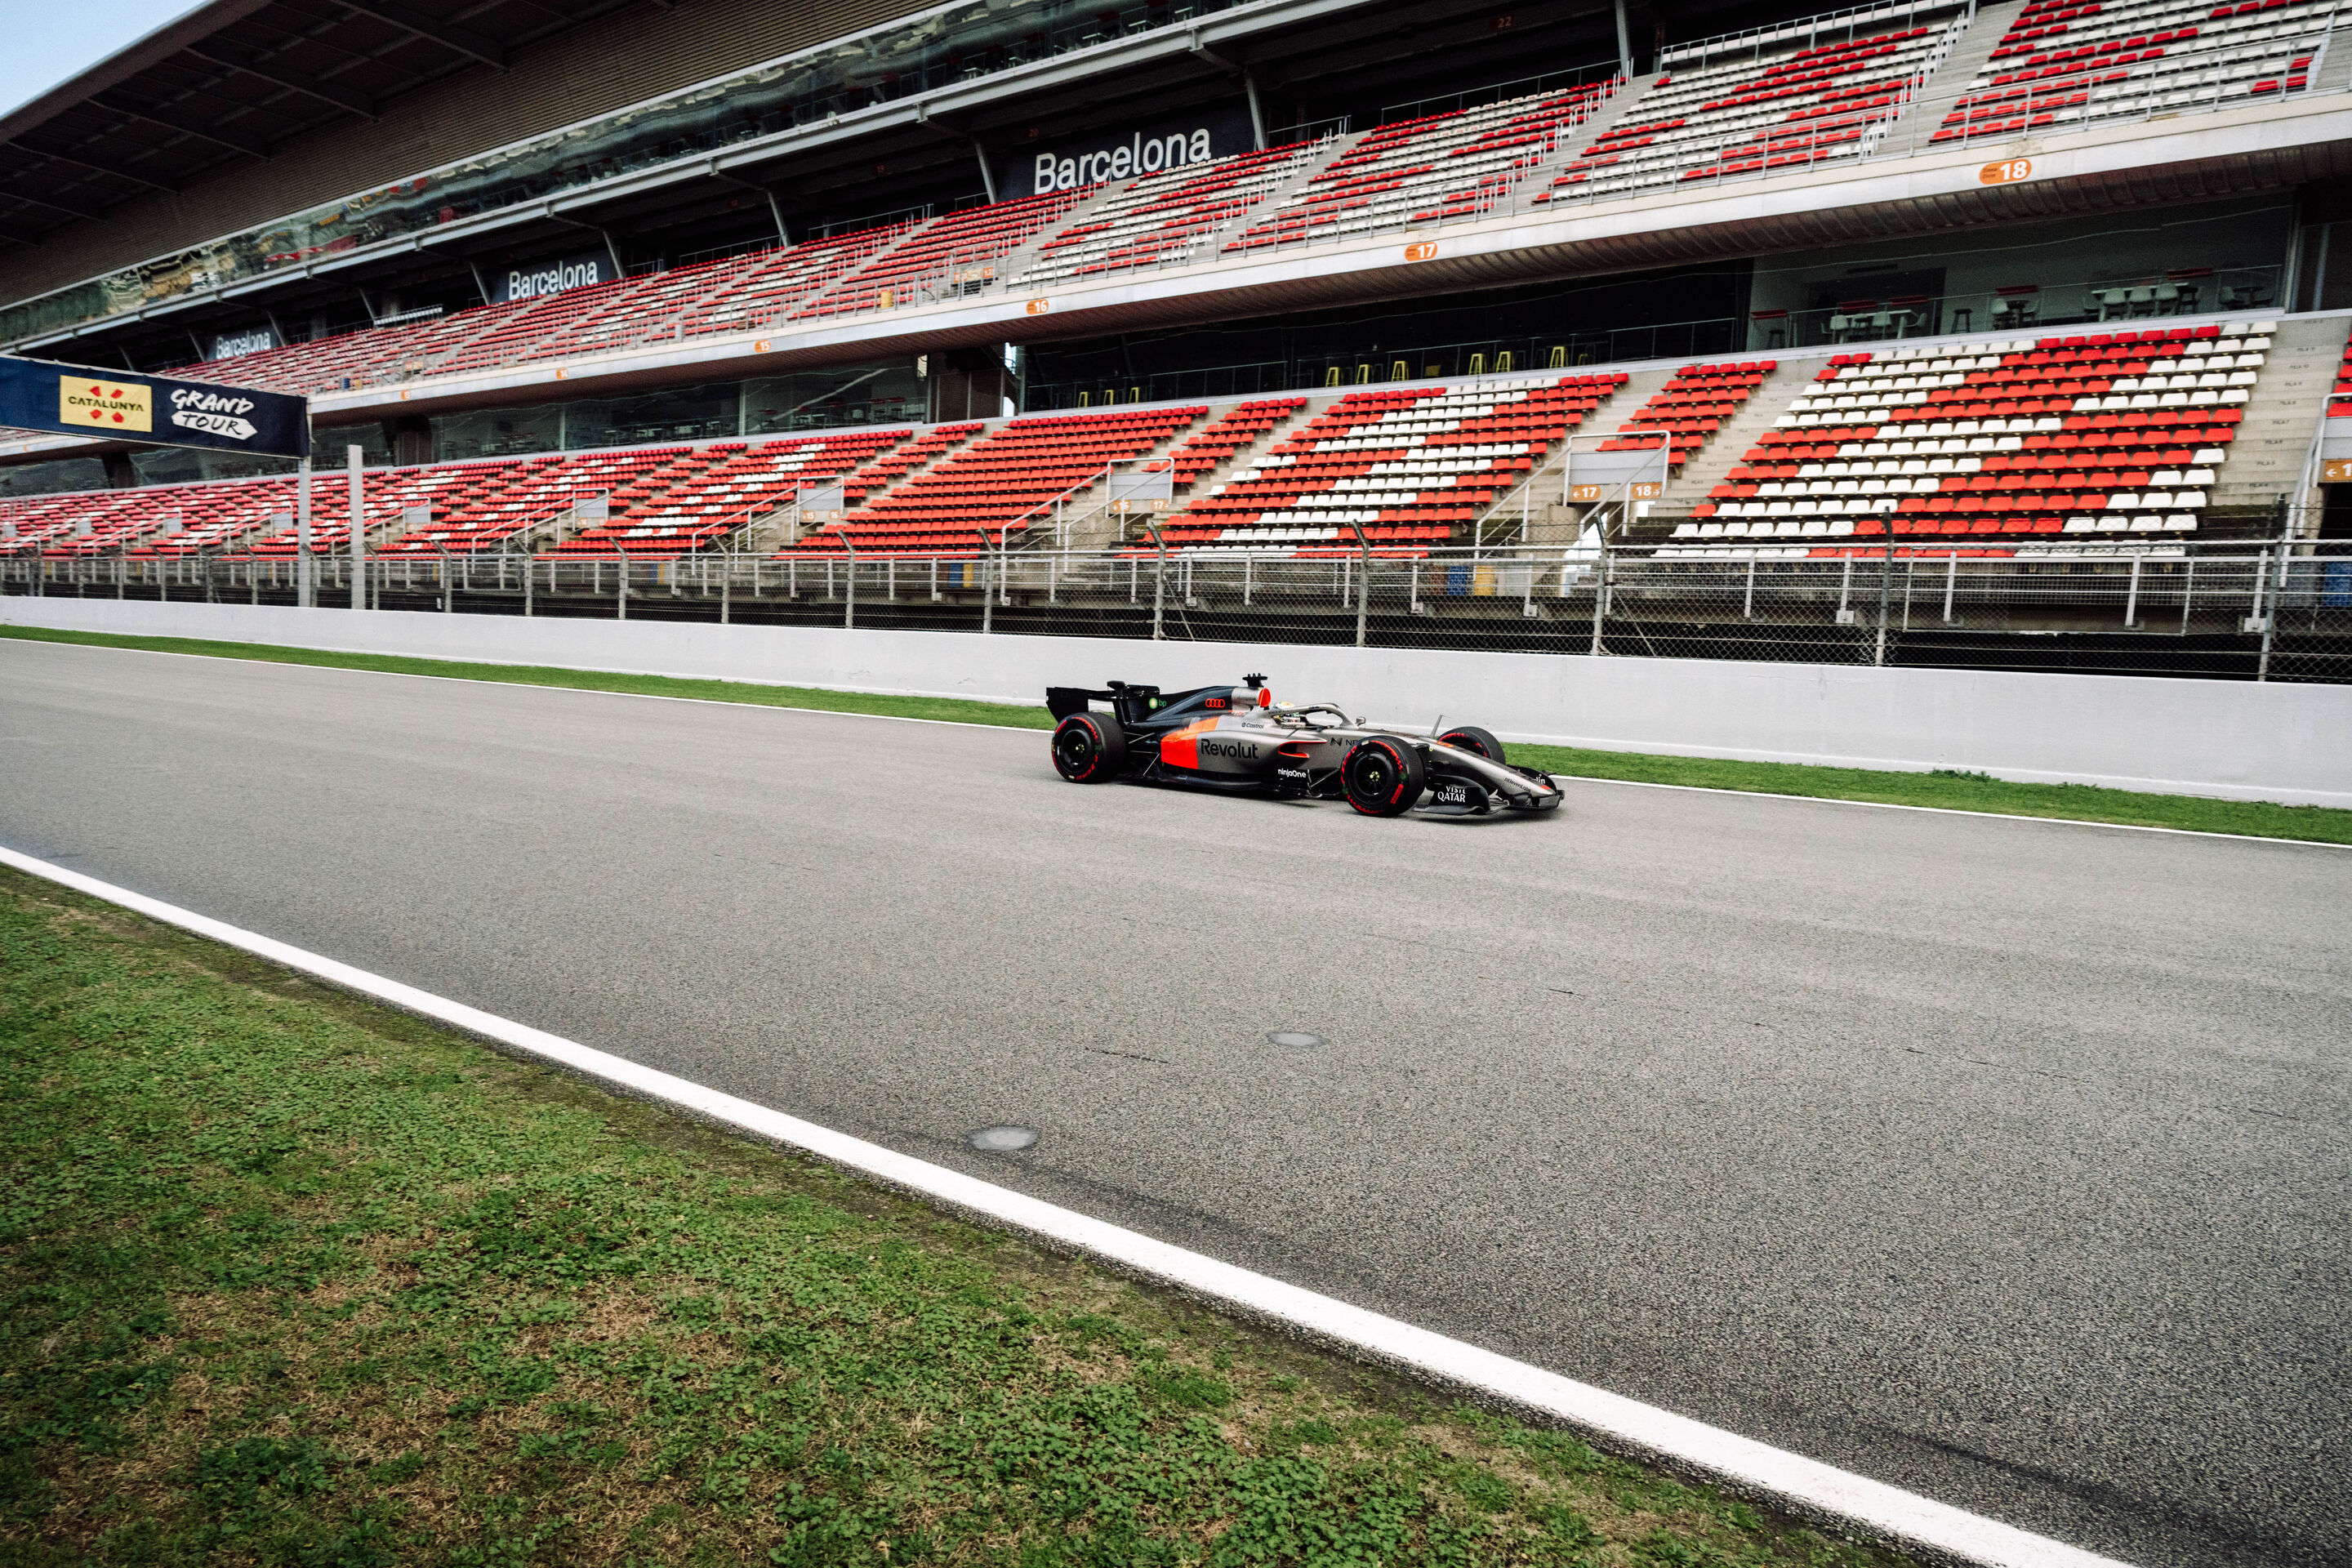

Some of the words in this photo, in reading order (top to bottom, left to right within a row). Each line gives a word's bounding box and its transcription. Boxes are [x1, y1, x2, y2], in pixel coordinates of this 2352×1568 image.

[1497, 16, 1512, 29] 22
[1034, 127, 1211, 195] Barcelona
[1999, 161, 2028, 180] 18
[1417, 243, 1436, 259] 17
[508, 261, 599, 301] Barcelona
[1034, 300, 1048, 313] 16
[216, 330, 271, 359] Barcelona
[760, 341, 770, 352] 15
[68, 395, 145, 412] CATALUNYA
[170, 388, 255, 415] GRAND
[182, 413, 243, 435] TOUR
[2342, 463, 2352, 477] 1
[1582, 487, 1597, 498] 17
[1636, 485, 1652, 497] 18
[1153, 501, 1164, 510] 17
[1158, 699, 1167, 707] bp
[1200, 737, 1259, 760] Revolut
[1277, 768, 1307, 778] ninjaOne
[1437, 791, 1466, 803] QATAR
